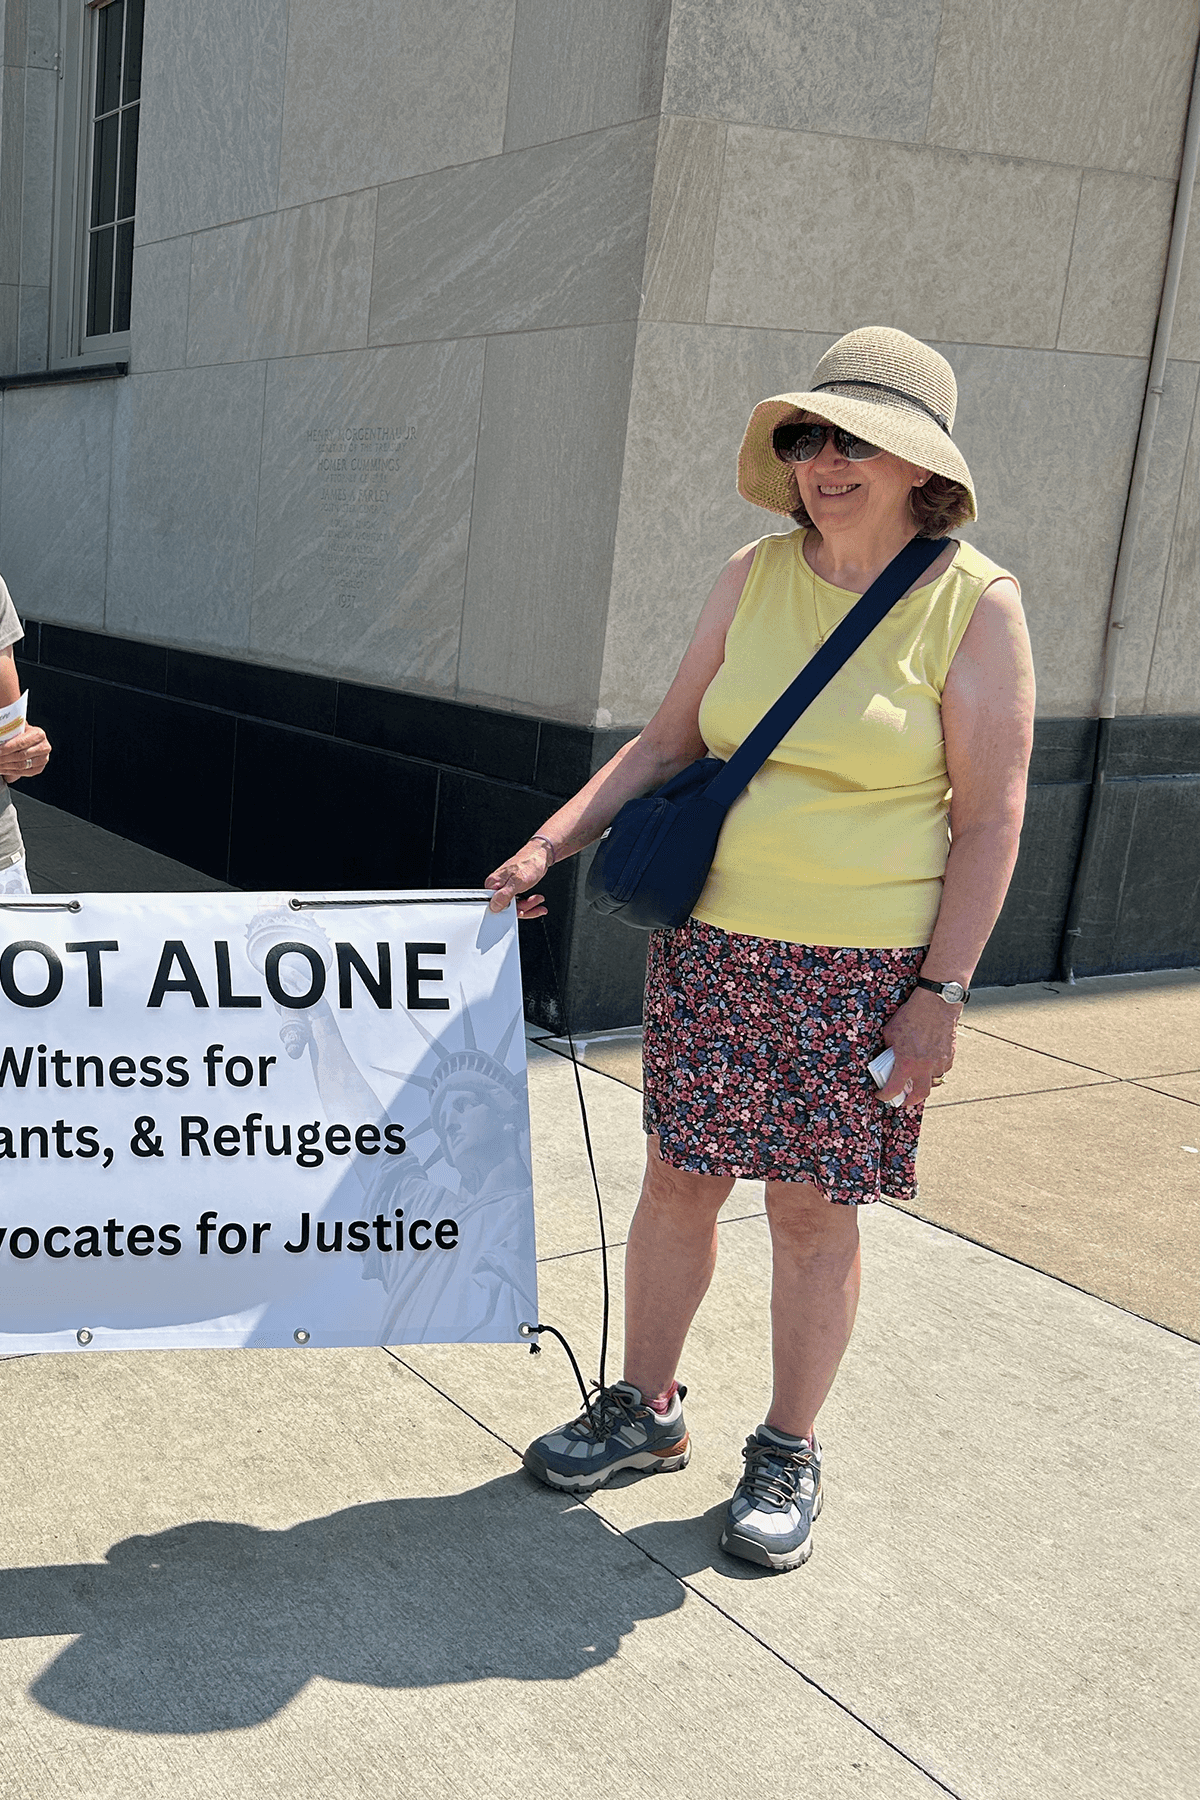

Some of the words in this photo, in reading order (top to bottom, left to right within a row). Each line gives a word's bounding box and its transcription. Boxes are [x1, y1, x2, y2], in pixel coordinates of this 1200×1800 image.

[404, 426, 417, 440] JR
[317, 458, 347, 471] HOMER
[350, 458, 401, 471] CUMMINGS
[320, 489, 346, 501] JAMES
[337, 594, 357, 608] 1937
[147, 941, 449, 1009] ALONE
[204, 1044, 276, 1086] for
[131, 1116, 163, 1157] &
[181, 1113, 406, 1167] Refugees
[197, 1212, 271, 1254] for
[284, 1209, 458, 1253] Justice
